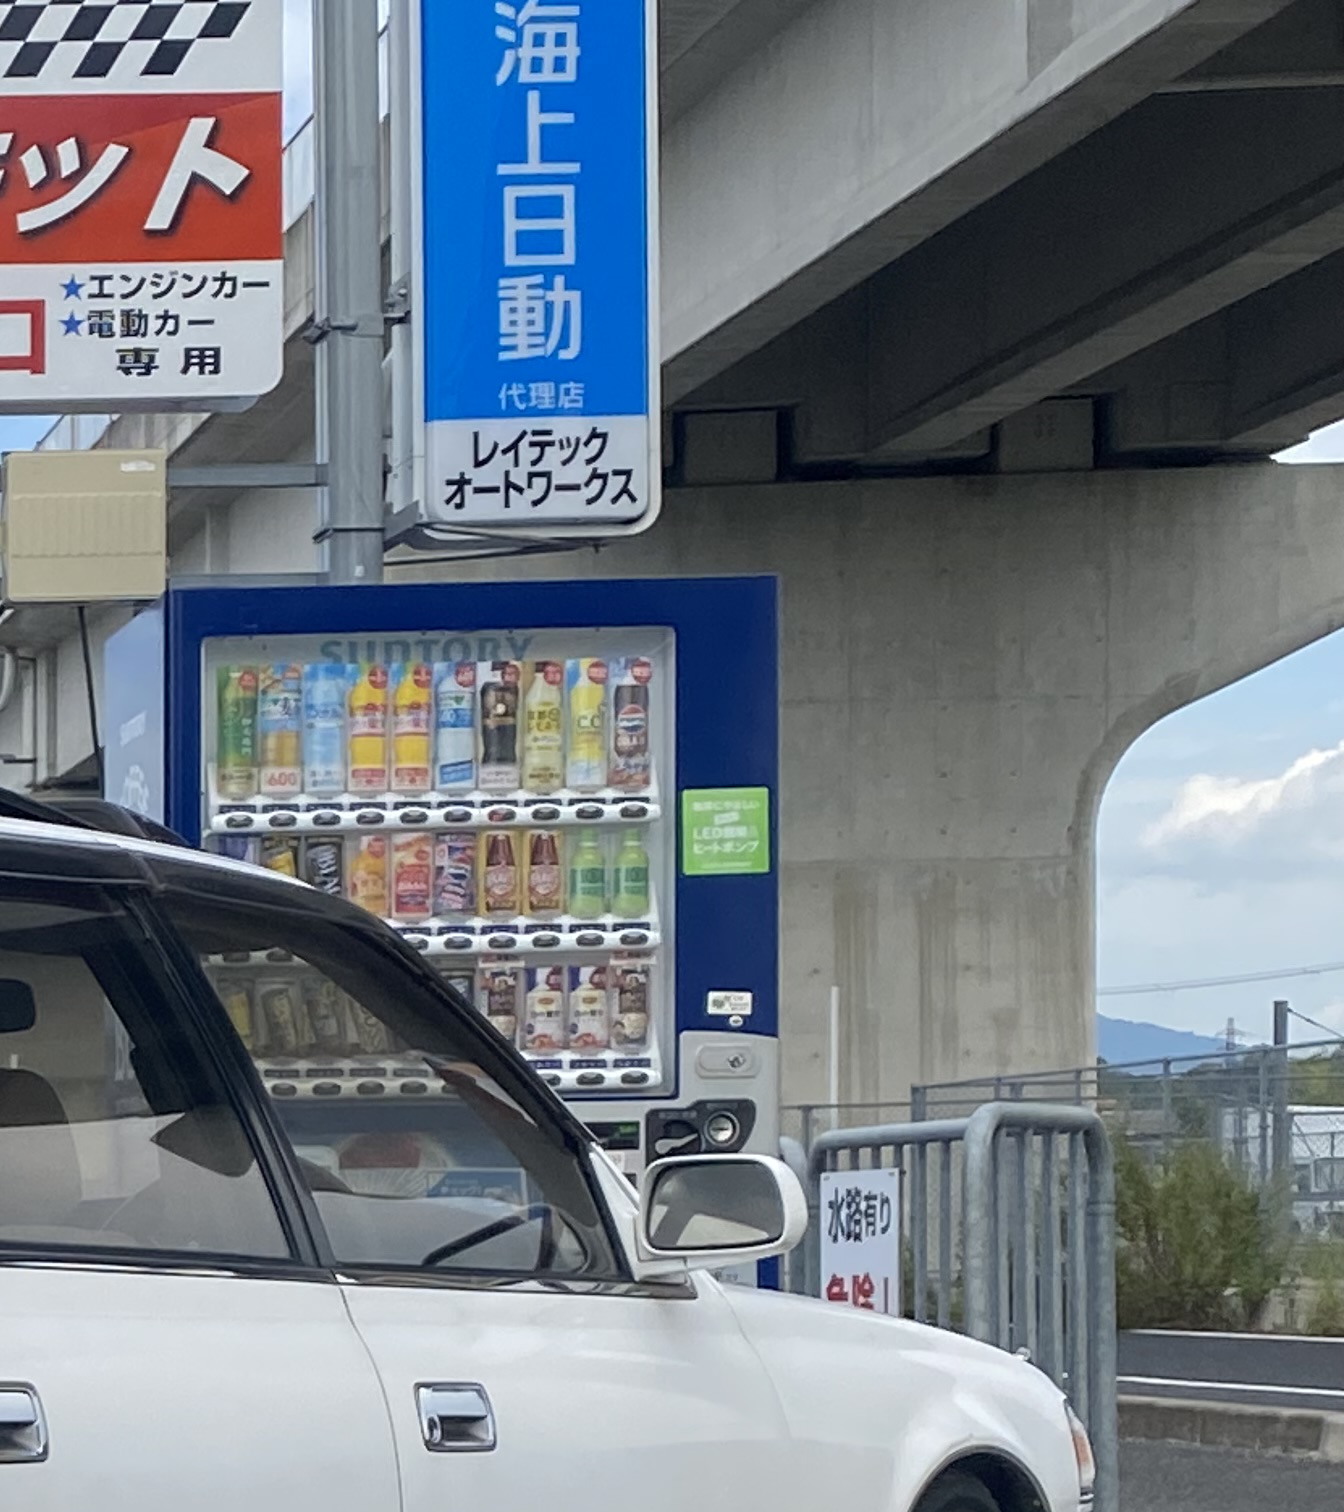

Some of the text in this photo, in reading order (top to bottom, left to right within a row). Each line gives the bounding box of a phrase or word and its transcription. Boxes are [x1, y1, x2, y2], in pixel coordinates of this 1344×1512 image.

[494, 0, 582, 362] 海上日動
[88, 271, 271, 300] エンジンカー
[87, 308, 215, 338] 電動カー
[498, 381, 585, 411] 代理店
[471, 426, 610, 469] レイテック
[444, 467, 639, 510] オートワークス
[828, 1186, 892, 1244] 水路有り
